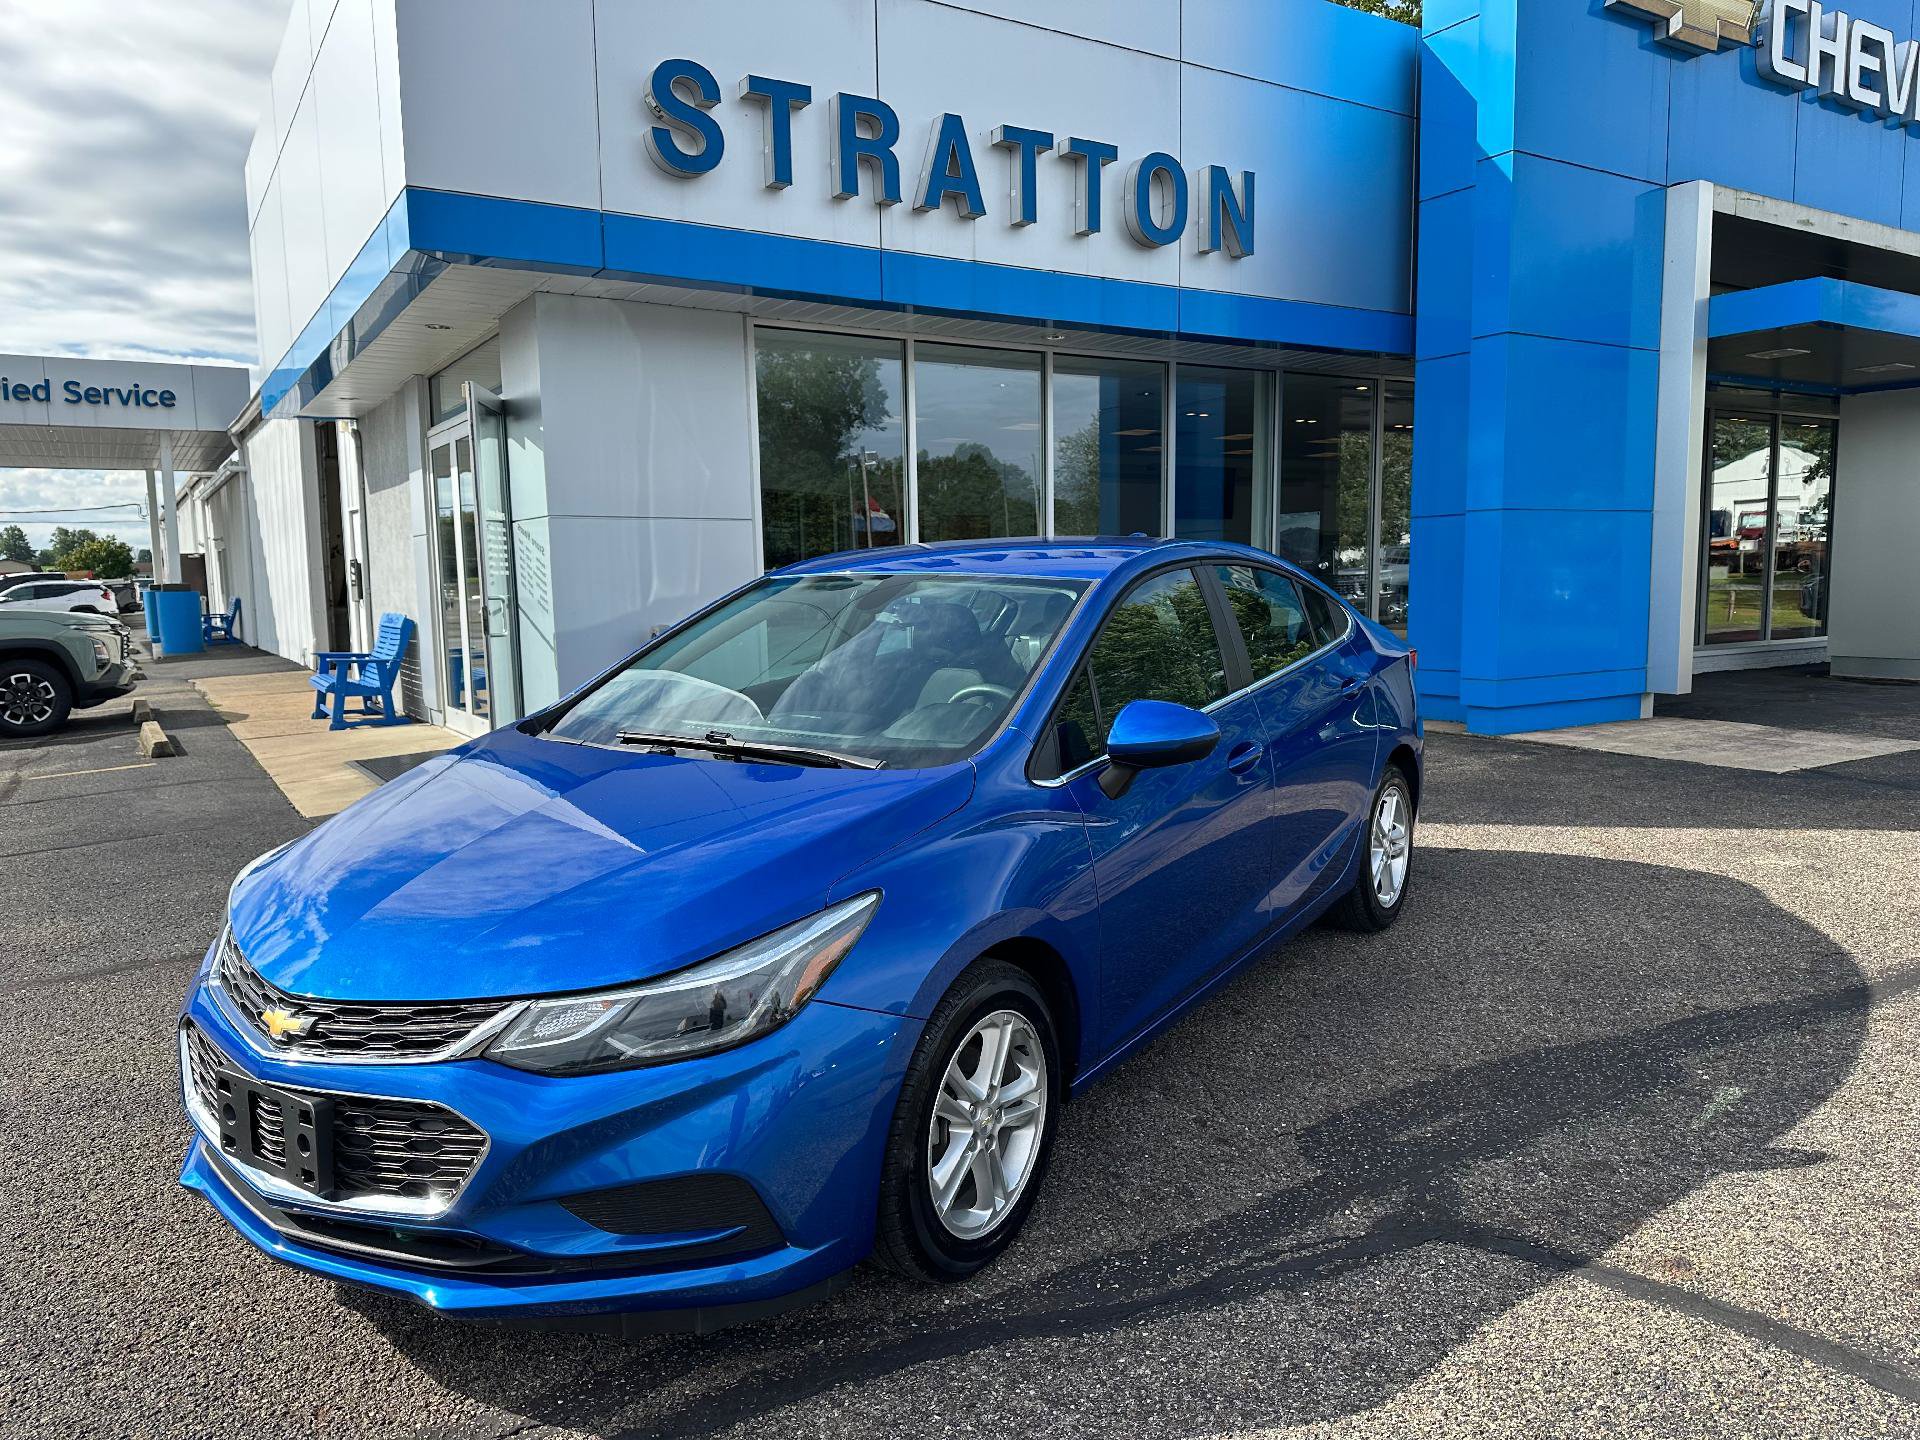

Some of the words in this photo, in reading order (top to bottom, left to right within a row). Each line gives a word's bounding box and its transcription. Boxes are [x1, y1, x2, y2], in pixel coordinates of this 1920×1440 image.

[1766, 0, 1920, 121] CHEV
[643, 58, 1256, 258] STRATTON
[0, 376, 51, 402] ied
[63, 380, 177, 408] Service
